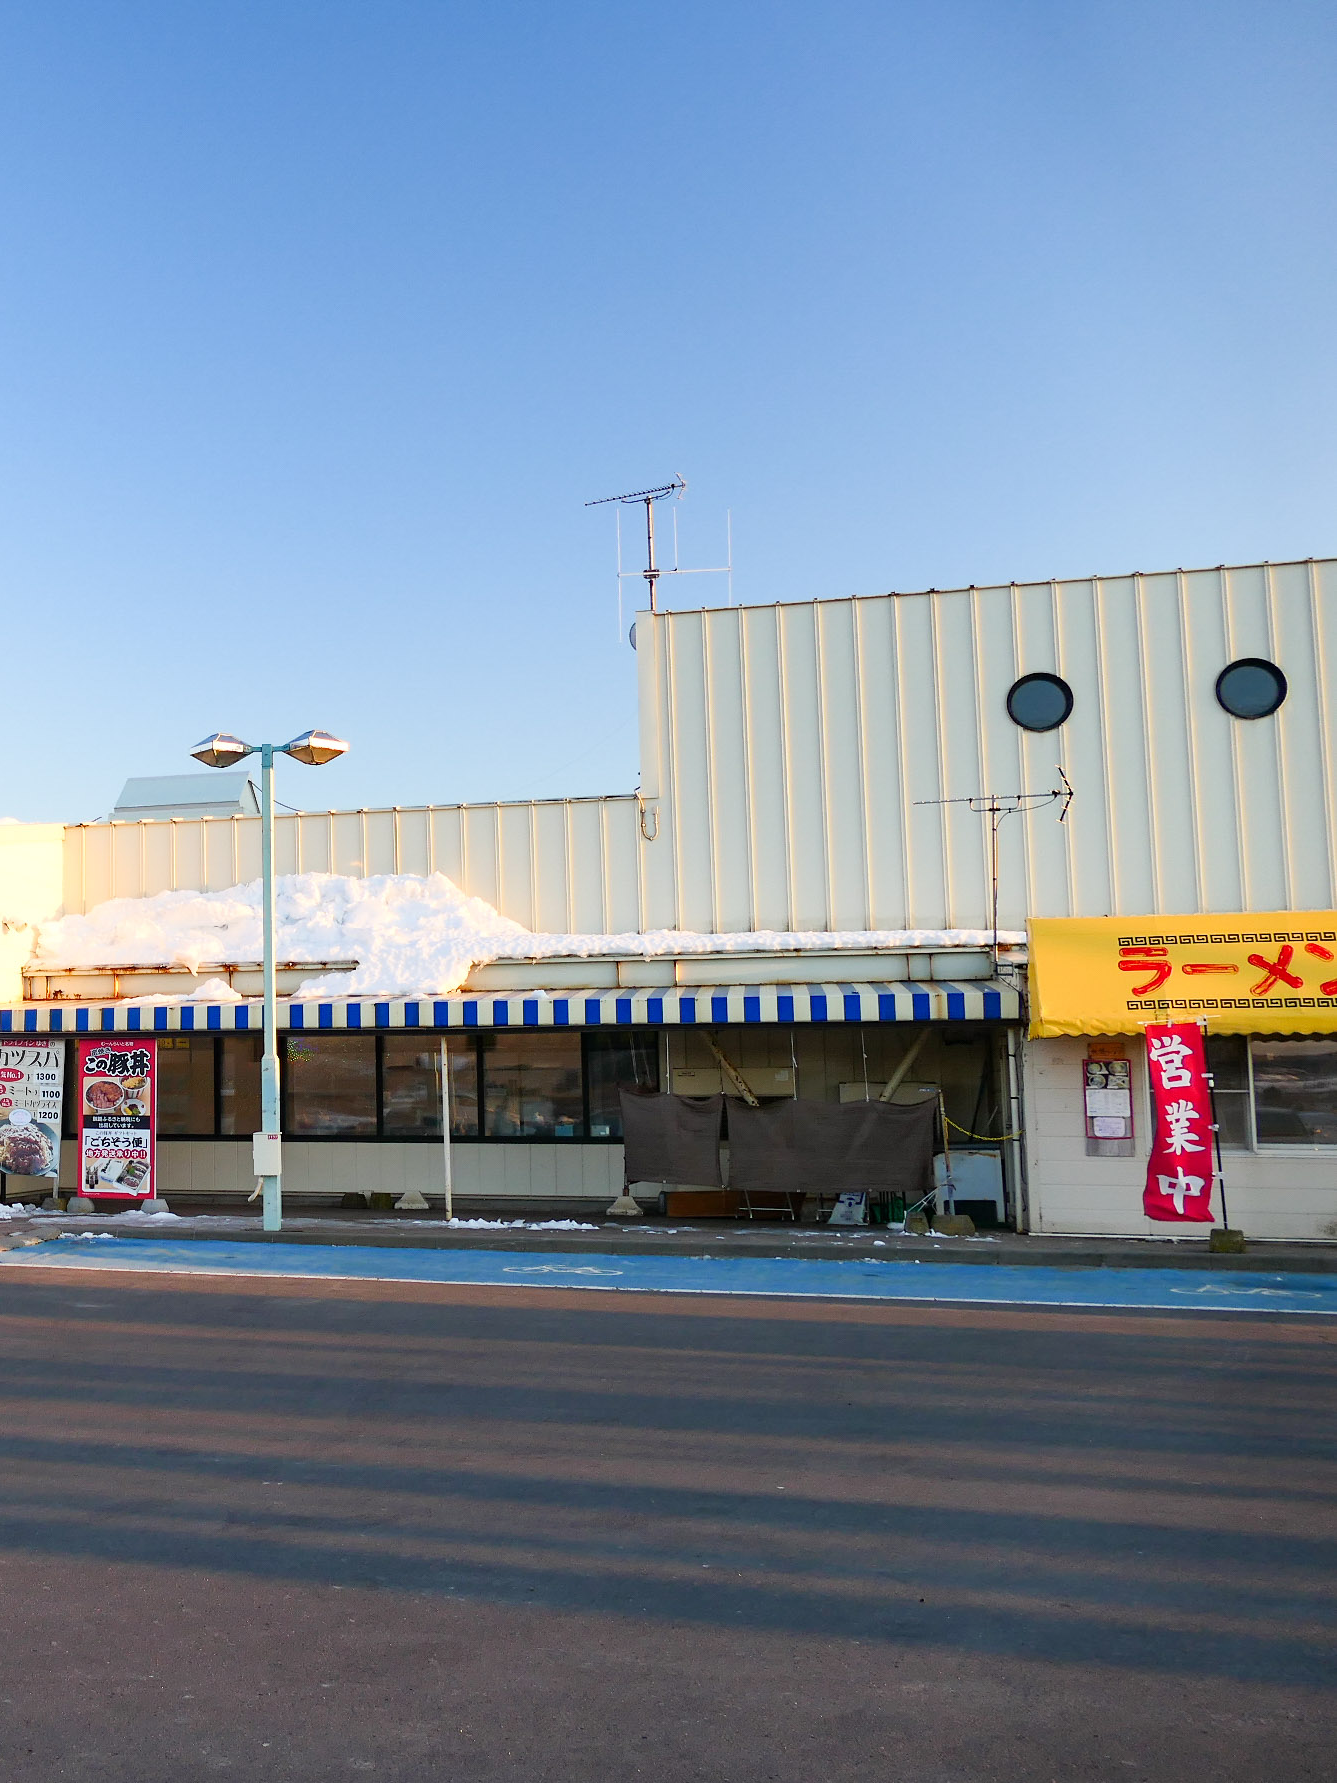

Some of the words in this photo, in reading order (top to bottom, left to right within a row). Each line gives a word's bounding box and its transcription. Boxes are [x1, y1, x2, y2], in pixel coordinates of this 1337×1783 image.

[85, 1050, 150, 1075] この豚丼
[1149, 1034, 1206, 1214] 営業中
[85, 1136, 147, 1148] 「ごちそう便」
